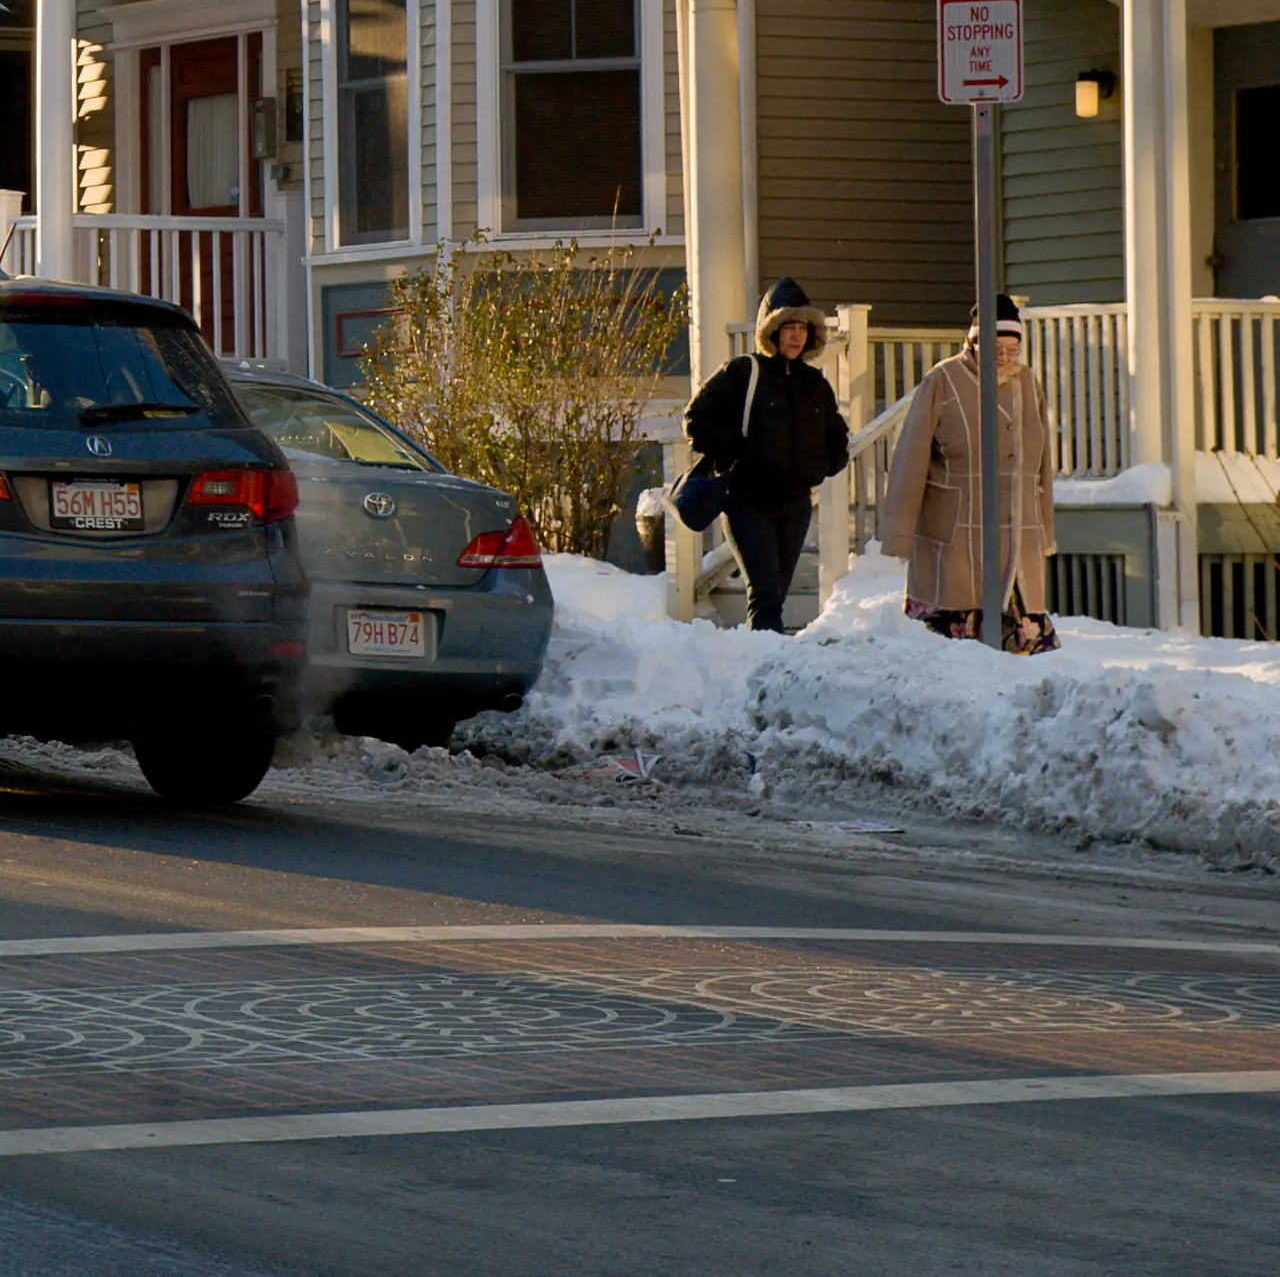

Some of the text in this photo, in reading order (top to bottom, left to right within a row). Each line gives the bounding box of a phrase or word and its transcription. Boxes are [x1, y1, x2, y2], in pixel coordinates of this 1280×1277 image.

[970, 6, 989, 21] NO
[947, 23, 1014, 41] STOPPING
[970, 46, 991, 57] ANY
[970, 61, 992, 72] TIME
[55, 489, 140, 517] 56M H55
[74, 517, 125, 529] CREST
[207, 512, 251, 522] RDX
[324, 547, 434, 562] AVALON
[351, 621, 420, 646] 79H B74
